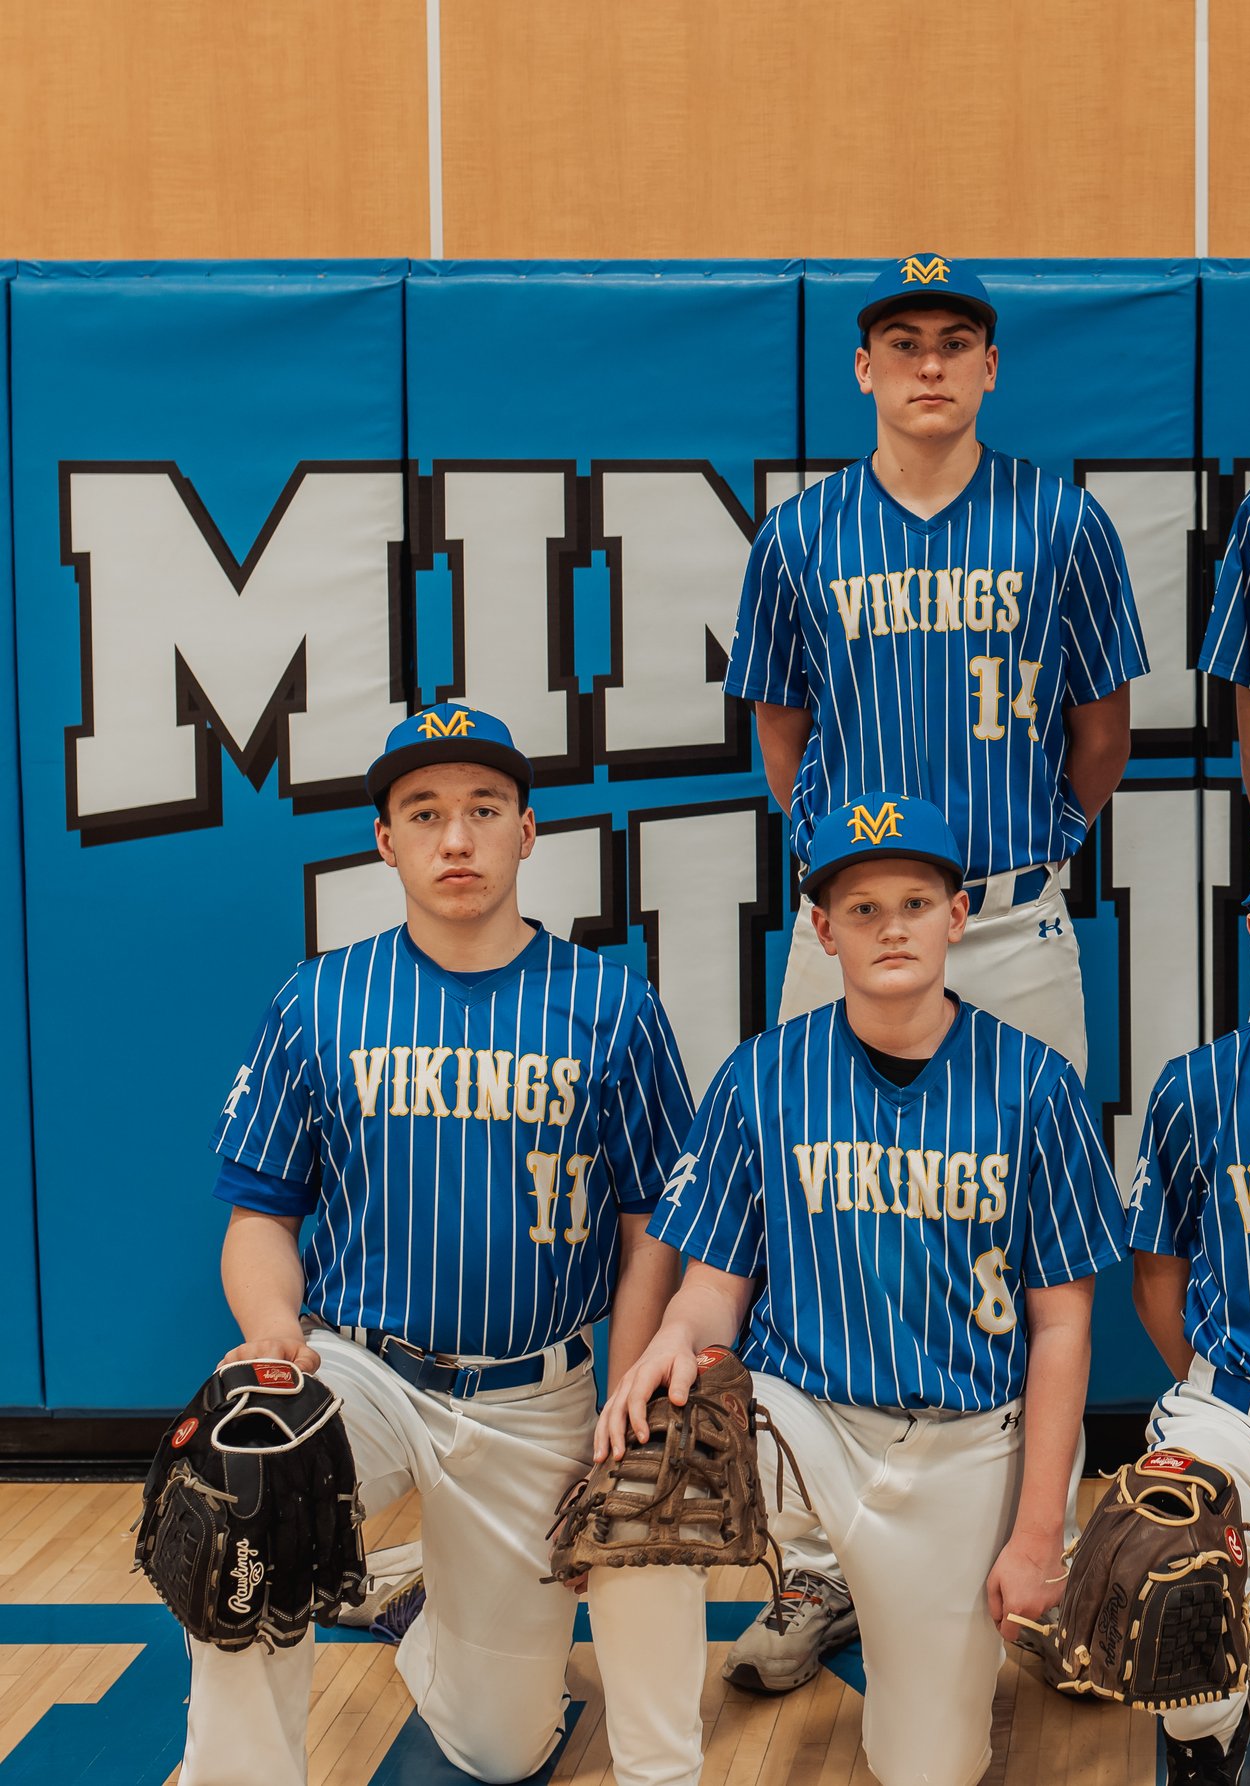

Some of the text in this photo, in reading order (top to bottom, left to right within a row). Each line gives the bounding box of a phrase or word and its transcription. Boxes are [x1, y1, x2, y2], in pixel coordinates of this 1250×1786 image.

[829, 567, 1024, 640] VIKINGS
[348, 1046, 581, 1126] VIKINGS
[526, 1150, 594, 1245] 11
[792, 1140, 1009, 1224] VIKINGS
[228, 1538, 258, 1613] Rawlings
[1100, 1582, 1129, 1668] Rawlings
